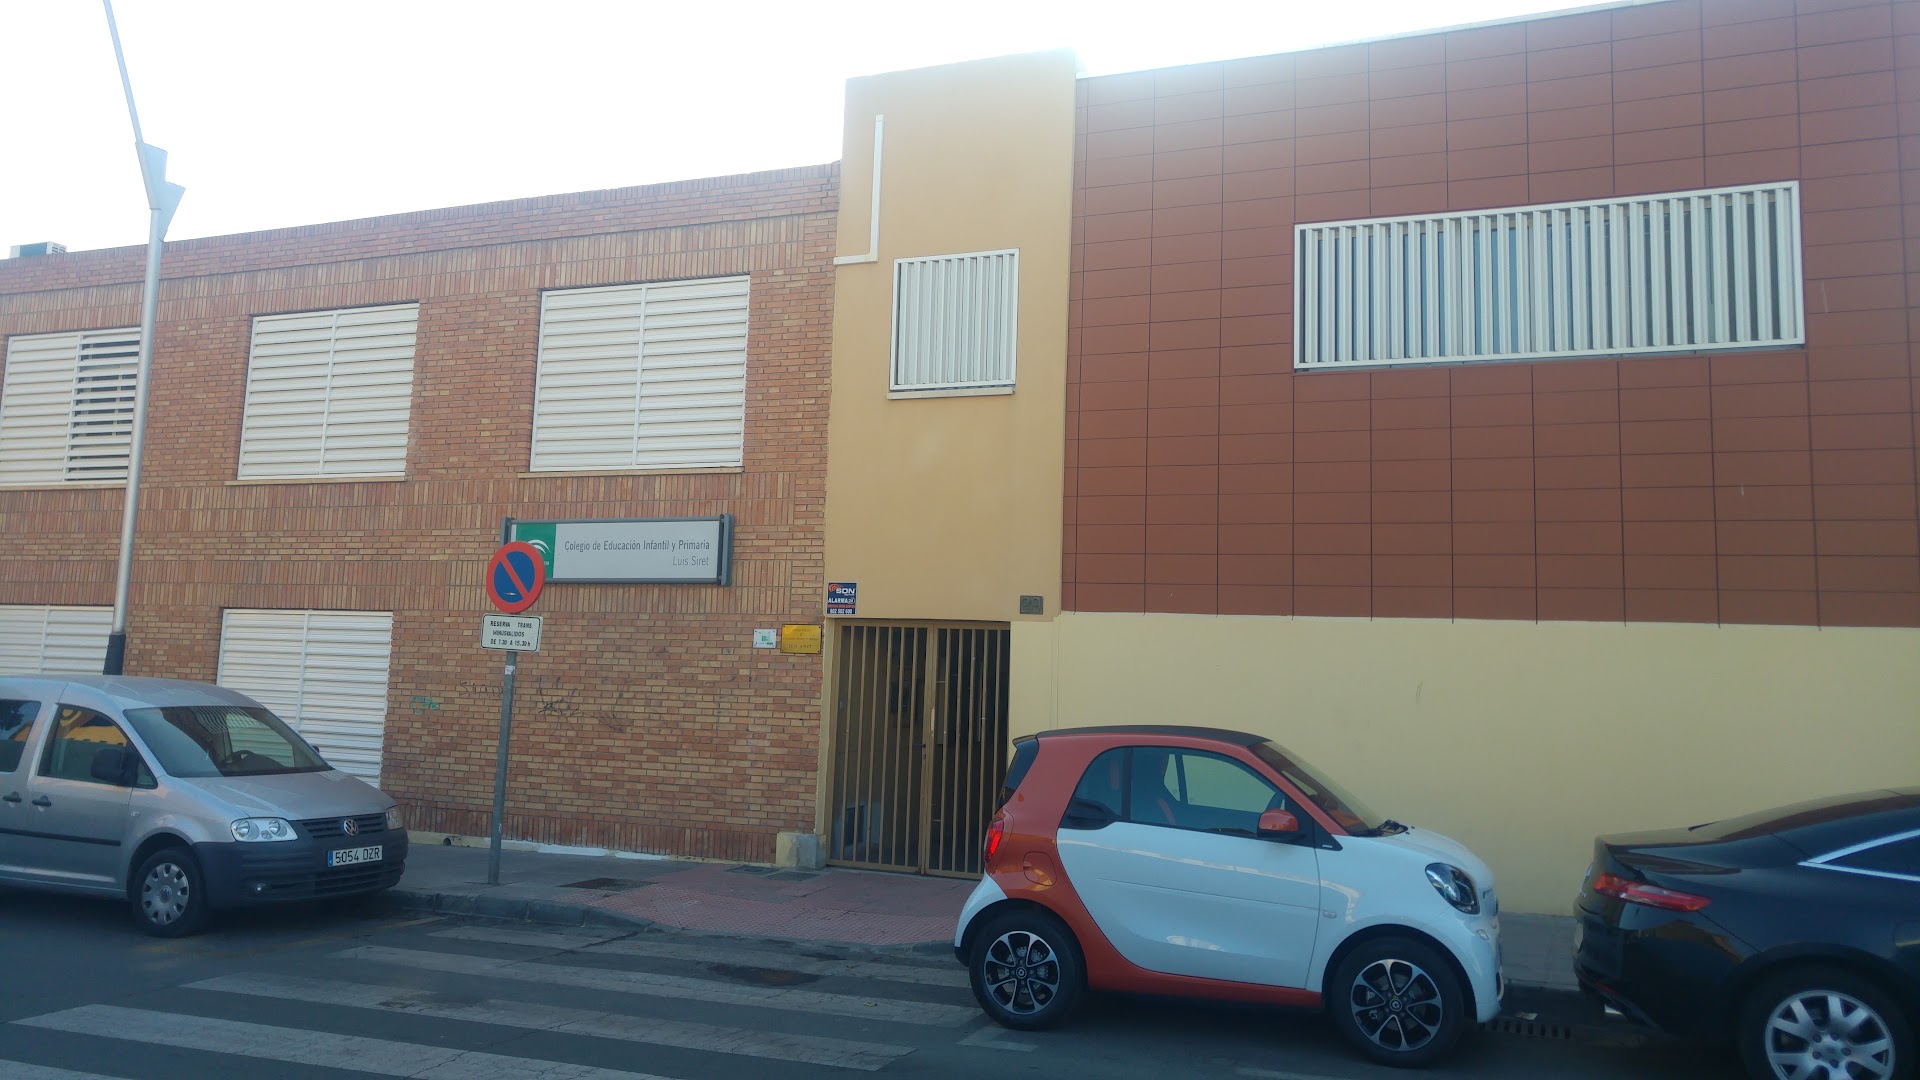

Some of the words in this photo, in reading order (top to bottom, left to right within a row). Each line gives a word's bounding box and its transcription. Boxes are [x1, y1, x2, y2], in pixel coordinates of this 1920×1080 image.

[564, 540, 591, 552] Colegio
[592, 541, 601, 550] de
[603, 540, 641, 551] Educación
[643, 540, 670, 550] Infantil
[671, 543, 676, 552] y
[678, 539, 710, 550] Primaria
[672, 556, 689, 566] Luis
[691, 556, 709, 566] Siret
[335, 850, 359, 863] 5054
[363, 847, 380, 860] DZR
